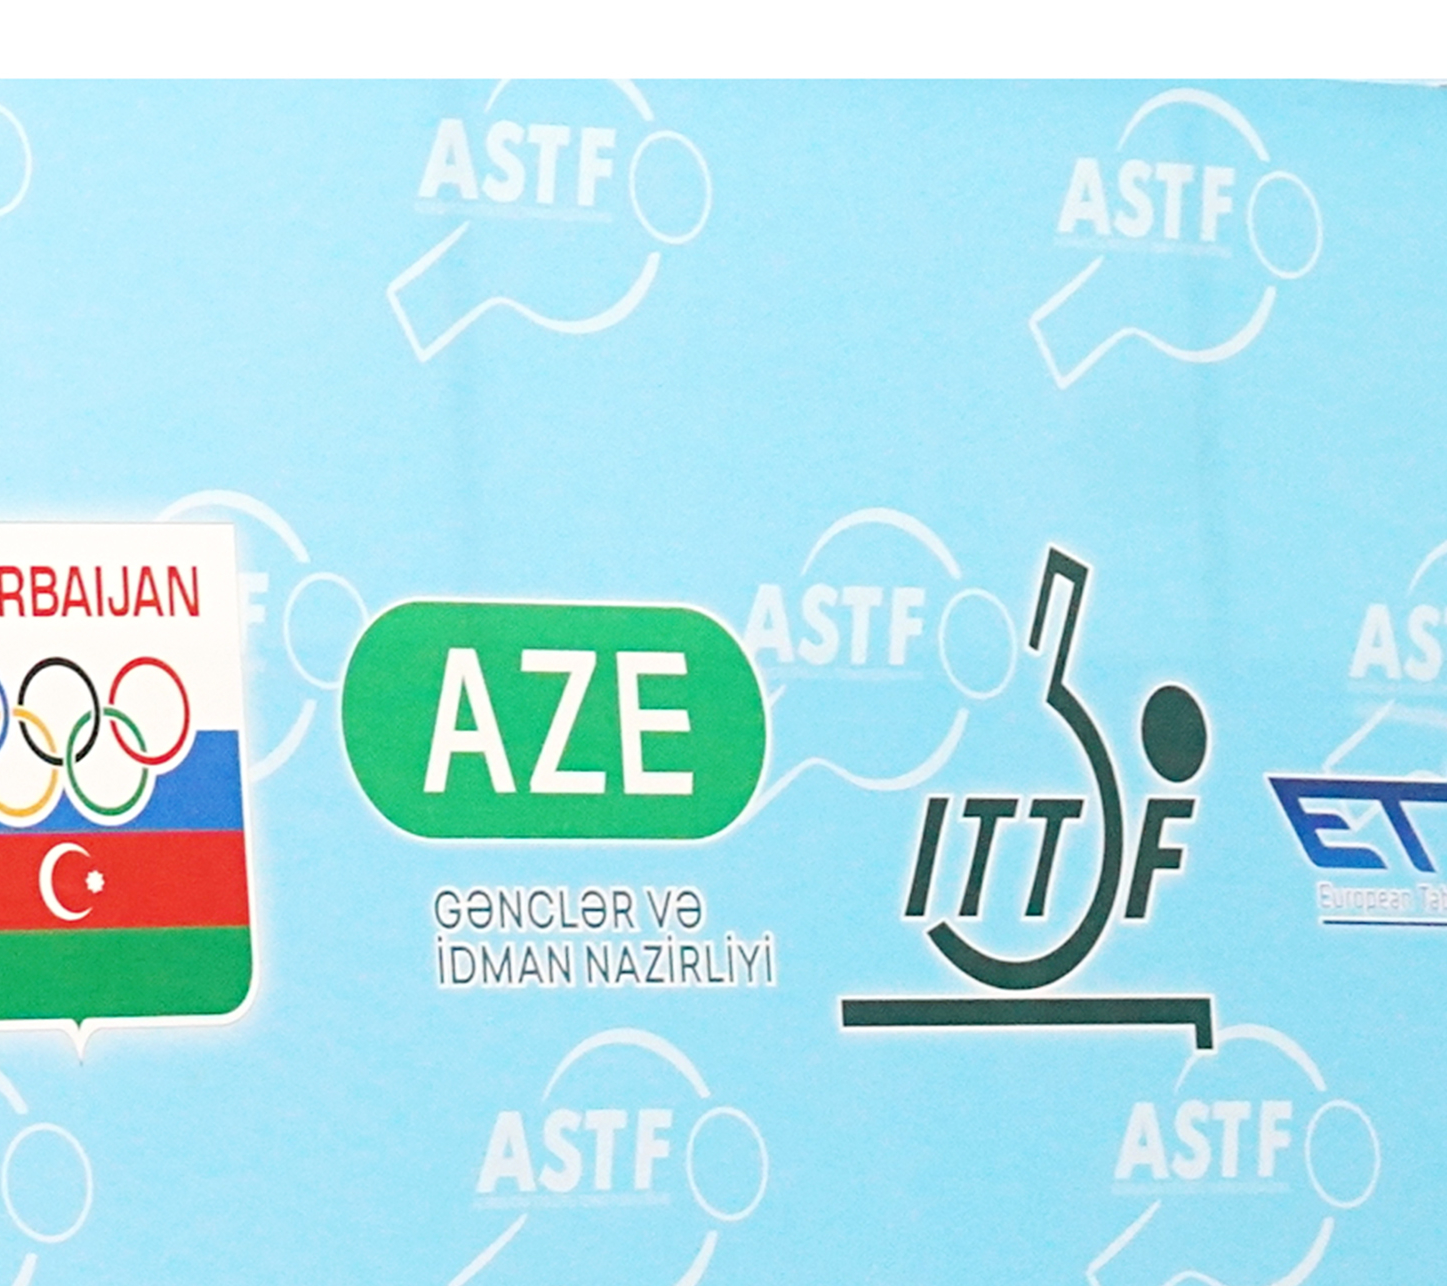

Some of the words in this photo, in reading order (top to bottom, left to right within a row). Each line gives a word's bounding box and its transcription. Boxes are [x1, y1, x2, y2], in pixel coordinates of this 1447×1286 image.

[419, 118, 616, 205] ASTF
[1058, 157, 1236, 241] ASTF
[745, 582, 925, 666] ASTF
[423, 648, 693, 795] AZE
[905, 797, 1196, 919] ITTF
[1317, 884, 1409, 912] European
[646, 890, 701, 928] VƏ
[436, 937, 571, 984] İDMAN
[475, 1108, 673, 1194] ASTF
[1115, 1100, 1293, 1180] ASTF
